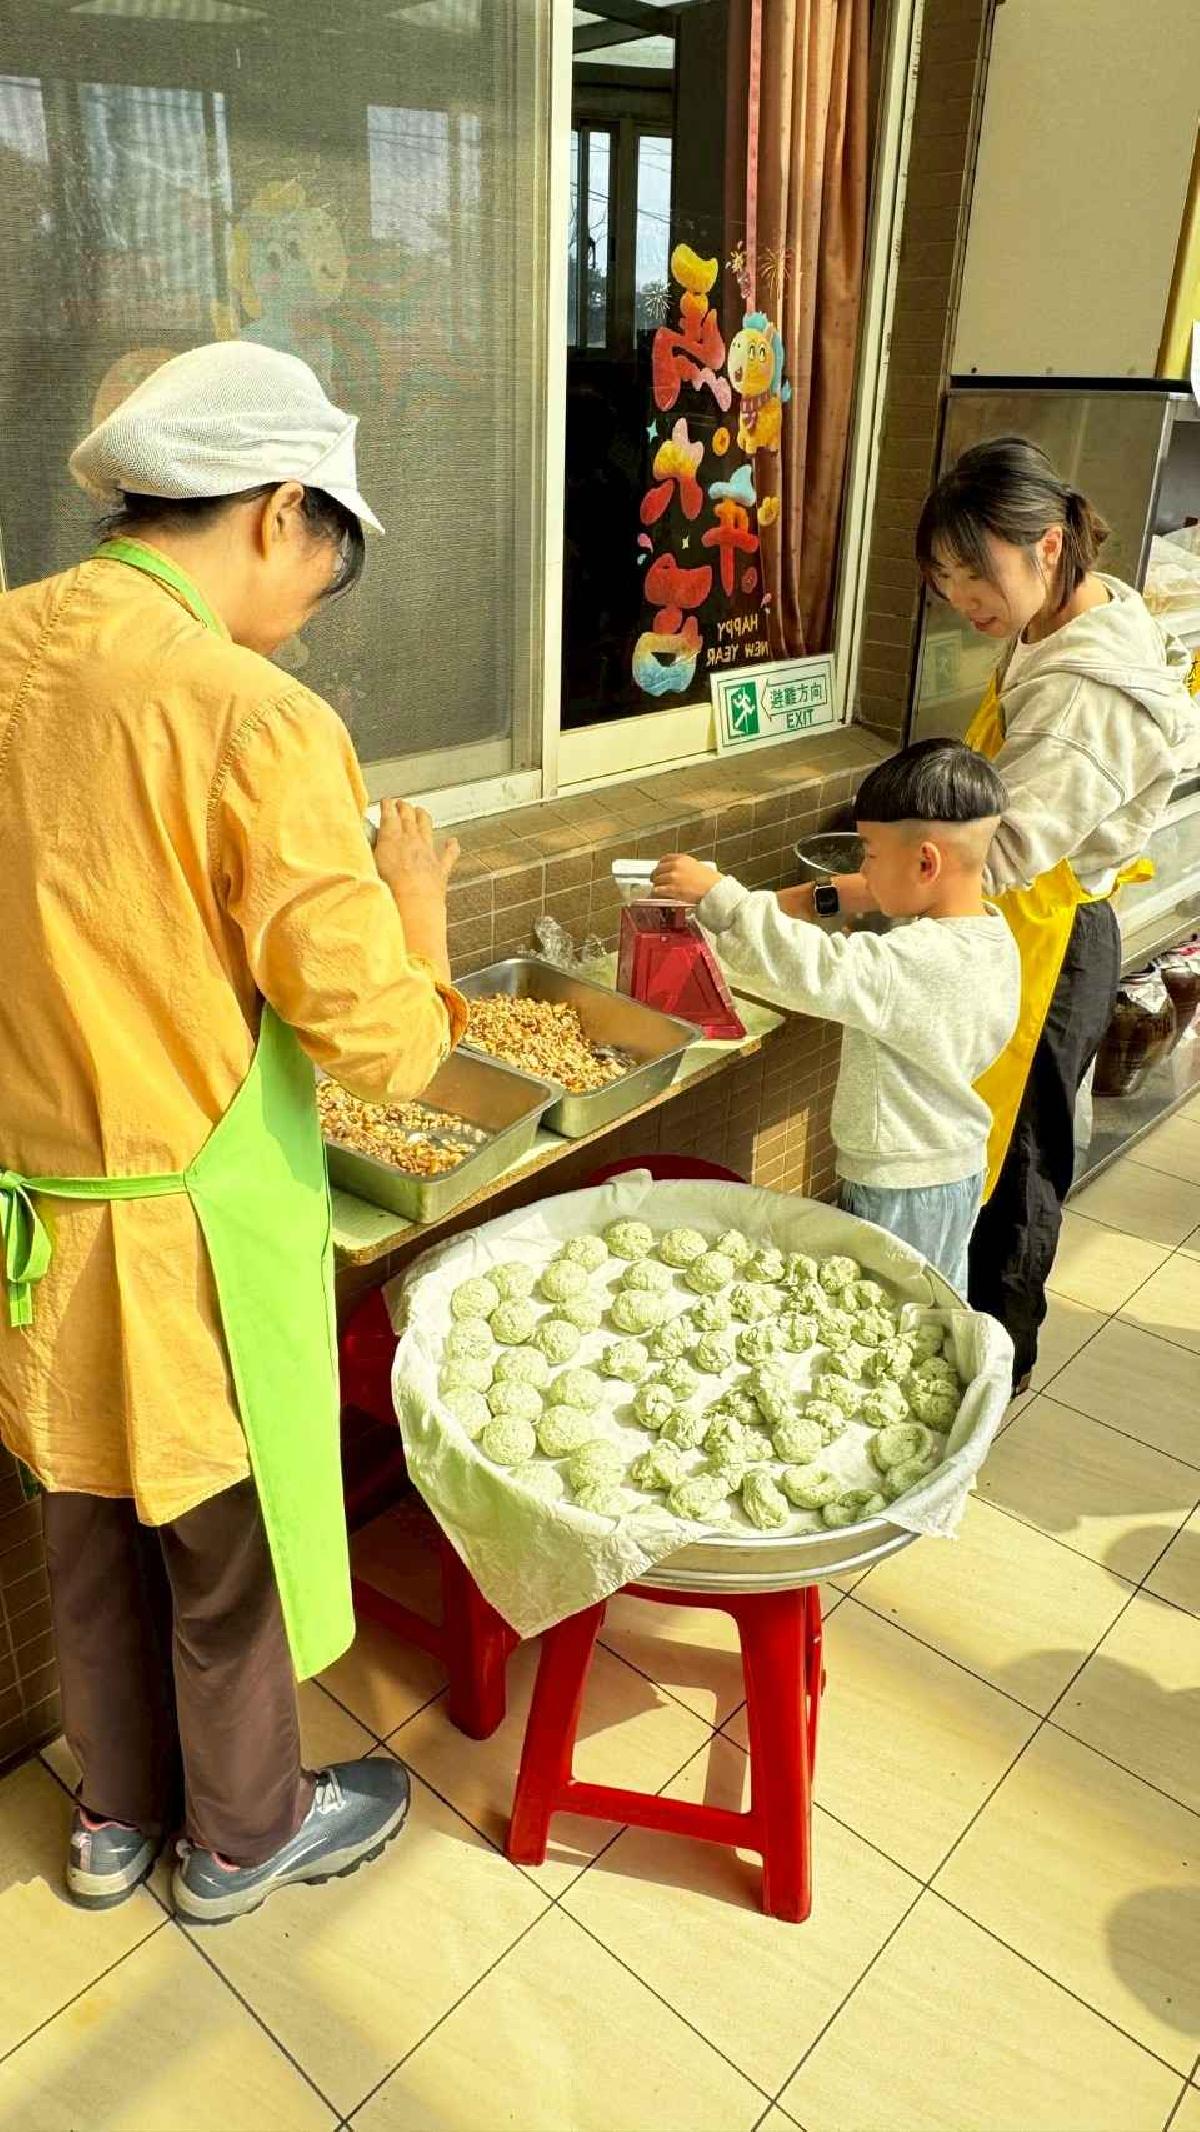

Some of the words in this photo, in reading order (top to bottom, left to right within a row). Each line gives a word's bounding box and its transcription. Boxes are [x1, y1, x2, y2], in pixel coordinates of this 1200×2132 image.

[770, 682, 822, 709] 避難方向
[786, 709, 814, 729] EXIT
